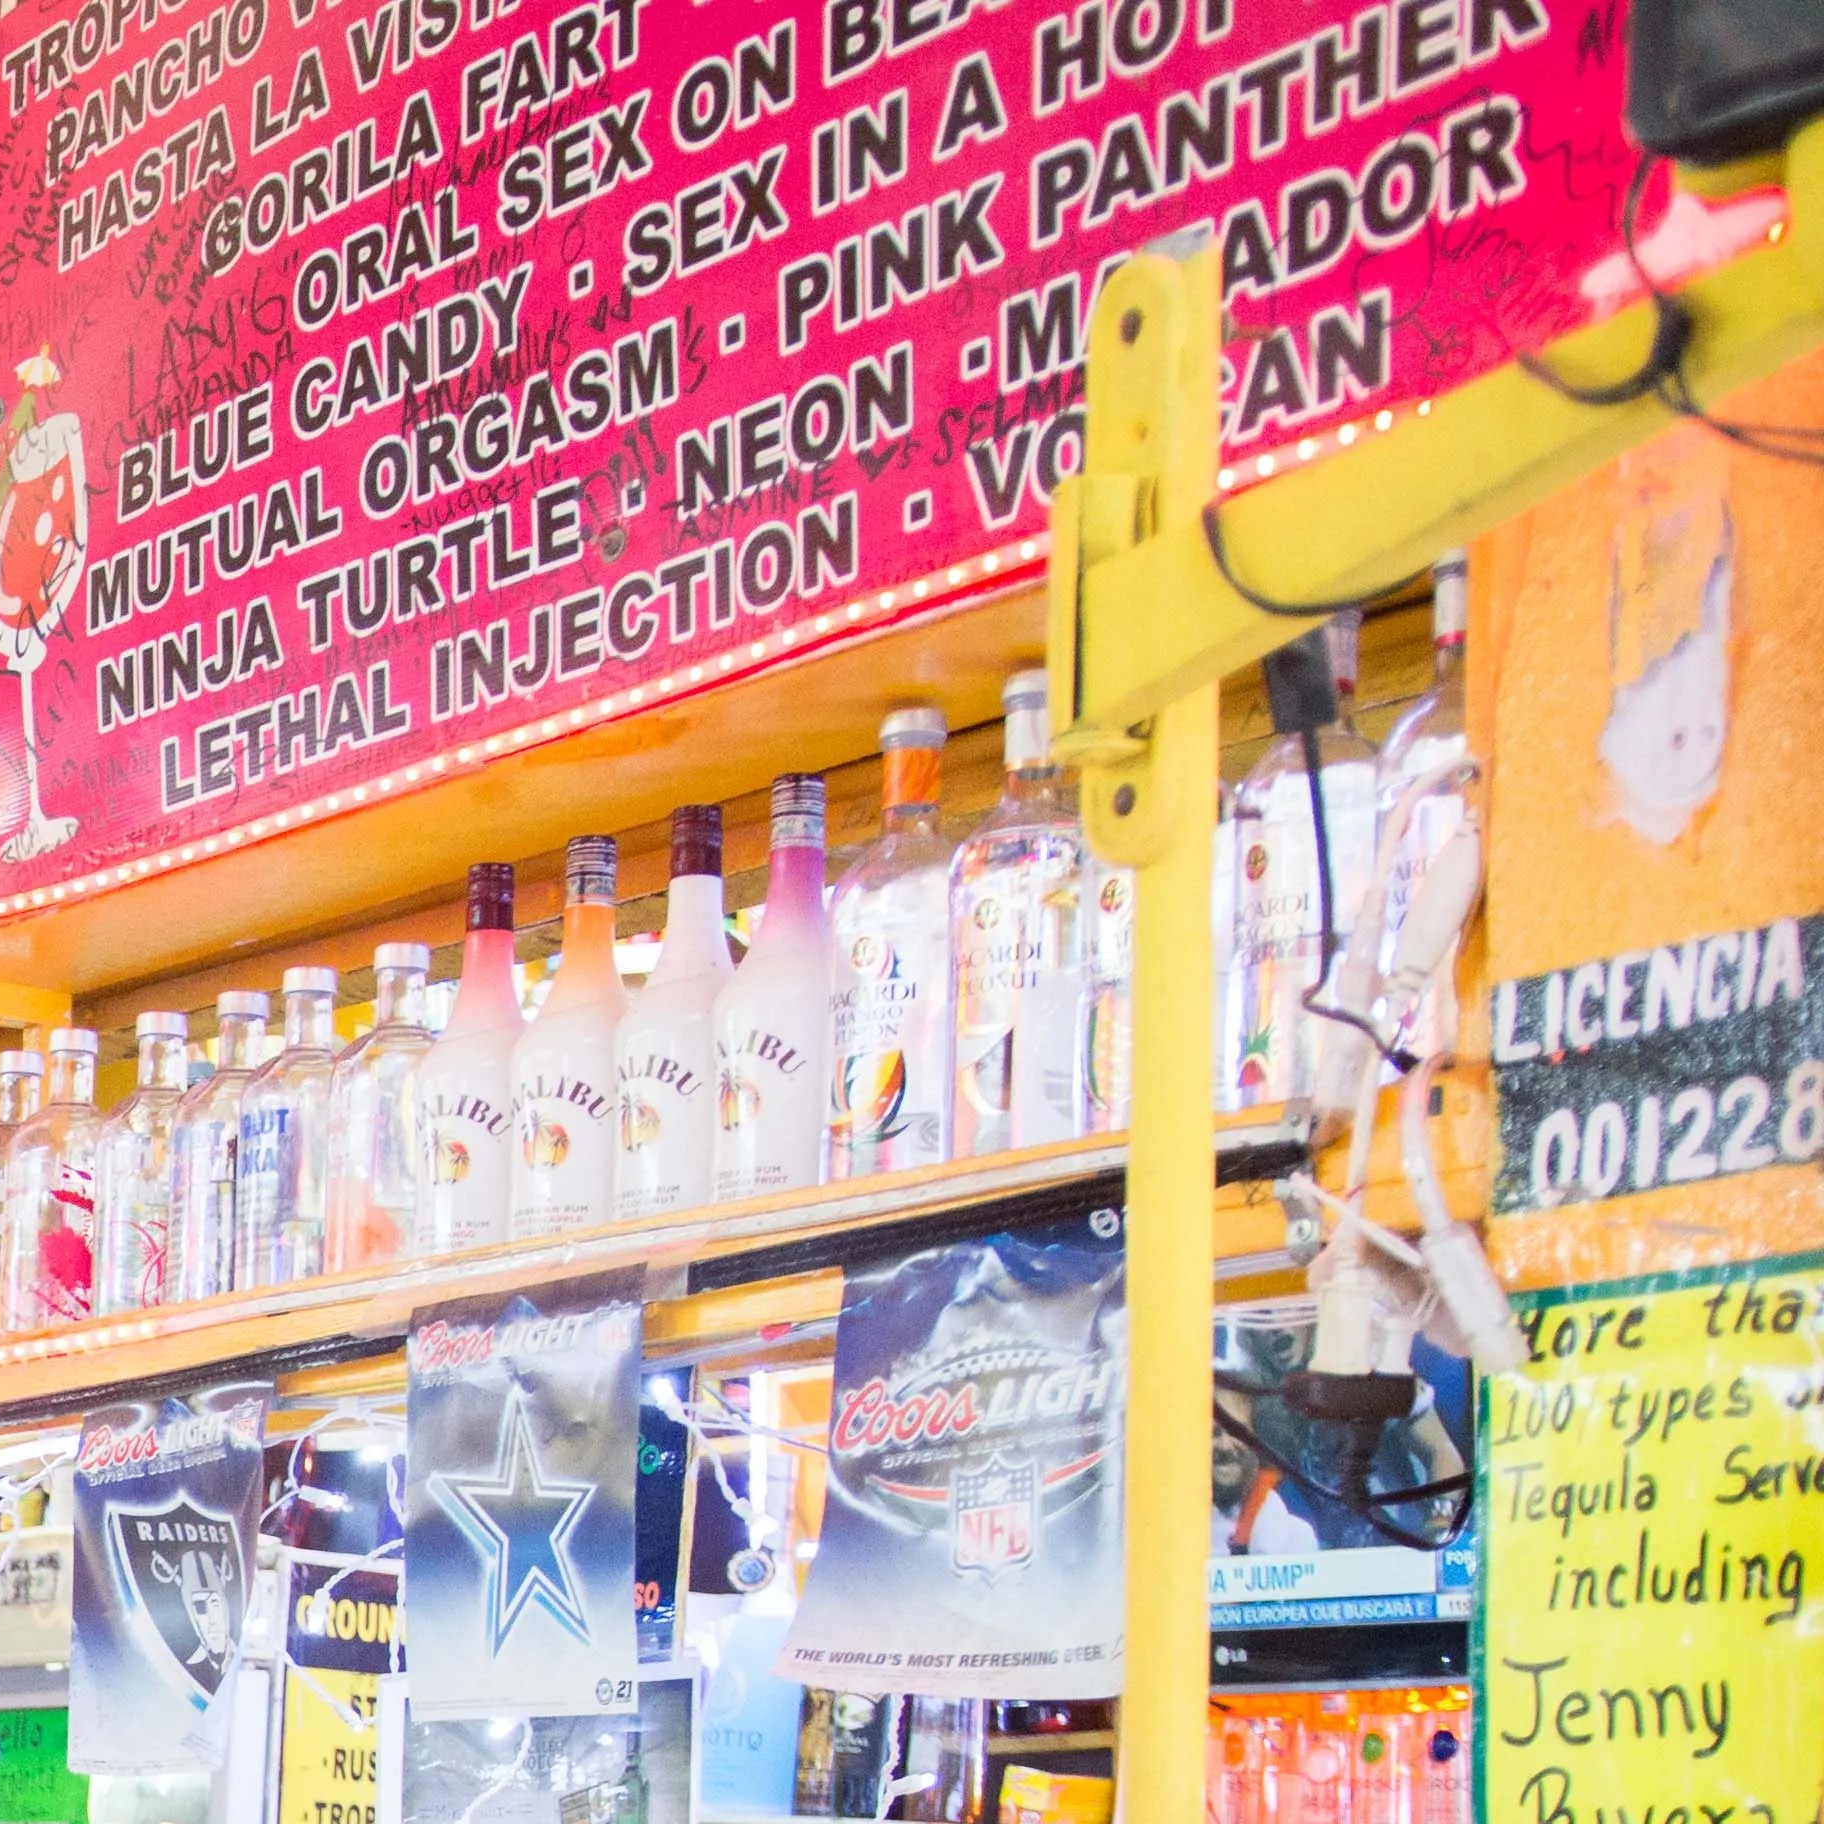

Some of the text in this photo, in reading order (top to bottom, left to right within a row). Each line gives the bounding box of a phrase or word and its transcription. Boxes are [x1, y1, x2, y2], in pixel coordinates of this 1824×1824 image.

[2, 0, 202, 117] TROPI
[46, 0, 266, 186] PANCHO
[58, 104, 236, 273] HASTA
[252, 47, 330, 155] LA
[347, 0, 527, 94] VIS
[202, 90, 443, 277] GORILA
[461, 0, 650, 146] FART
[294, 188, 479, 331] ORAL
[497, 89, 652, 236] SEX
[672, 18, 795, 150] ON
[86, 468, 342, 637] MUTUAL
[360, 316, 678, 520] ORGASM
[779, 172, 1005, 357] PINK
[1030, 0, 1549, 249] PANTHER
[117, 382, 272, 523] BLUE
[292, 262, 533, 441] CANDY
[623, 145, 788, 294] SEX
[812, 87, 908, 216] IN
[932, 50, 1008, 162] A
[97, 597, 284, 734] NINJA
[297, 477, 581, 652] TURTLE
[675, 342, 914, 520] NEON
[1000, 95, 1526, 394] MADOR
[160, 288, 1392, 813] LETHAL INJECTION VOAN
[1493, 917, 1804, 1063] LICENCIA
[413, 1319, 495, 1372] Coors
[80, 1424, 160, 1473] Coors
[833, 1376, 980, 1456] Coors
[1493, 1374, 1756, 1449] 100 types
[135, 1520, 230, 1545] RAIDERS
[960, 1508, 1032, 1558] NFL
[1502, 1451, 1659, 1540] Tequila
[1233, 1562, 1316, 1592] "JUMP"
[1243, 1601, 1309, 1625] EUROPEA
[1312, 1600, 1342, 1622] QUE
[1548, 1526, 1807, 1627] including
[615, 1679, 633, 1700] 21
[794, 1648, 825, 1662] THE
[828, 1650, 901, 1667] WORLD'S
[906, 1653, 954, 1669] MOST
[958, 1650, 1058, 1669] REFRESHING
[1500, 1655, 1729, 1759] Jenny
